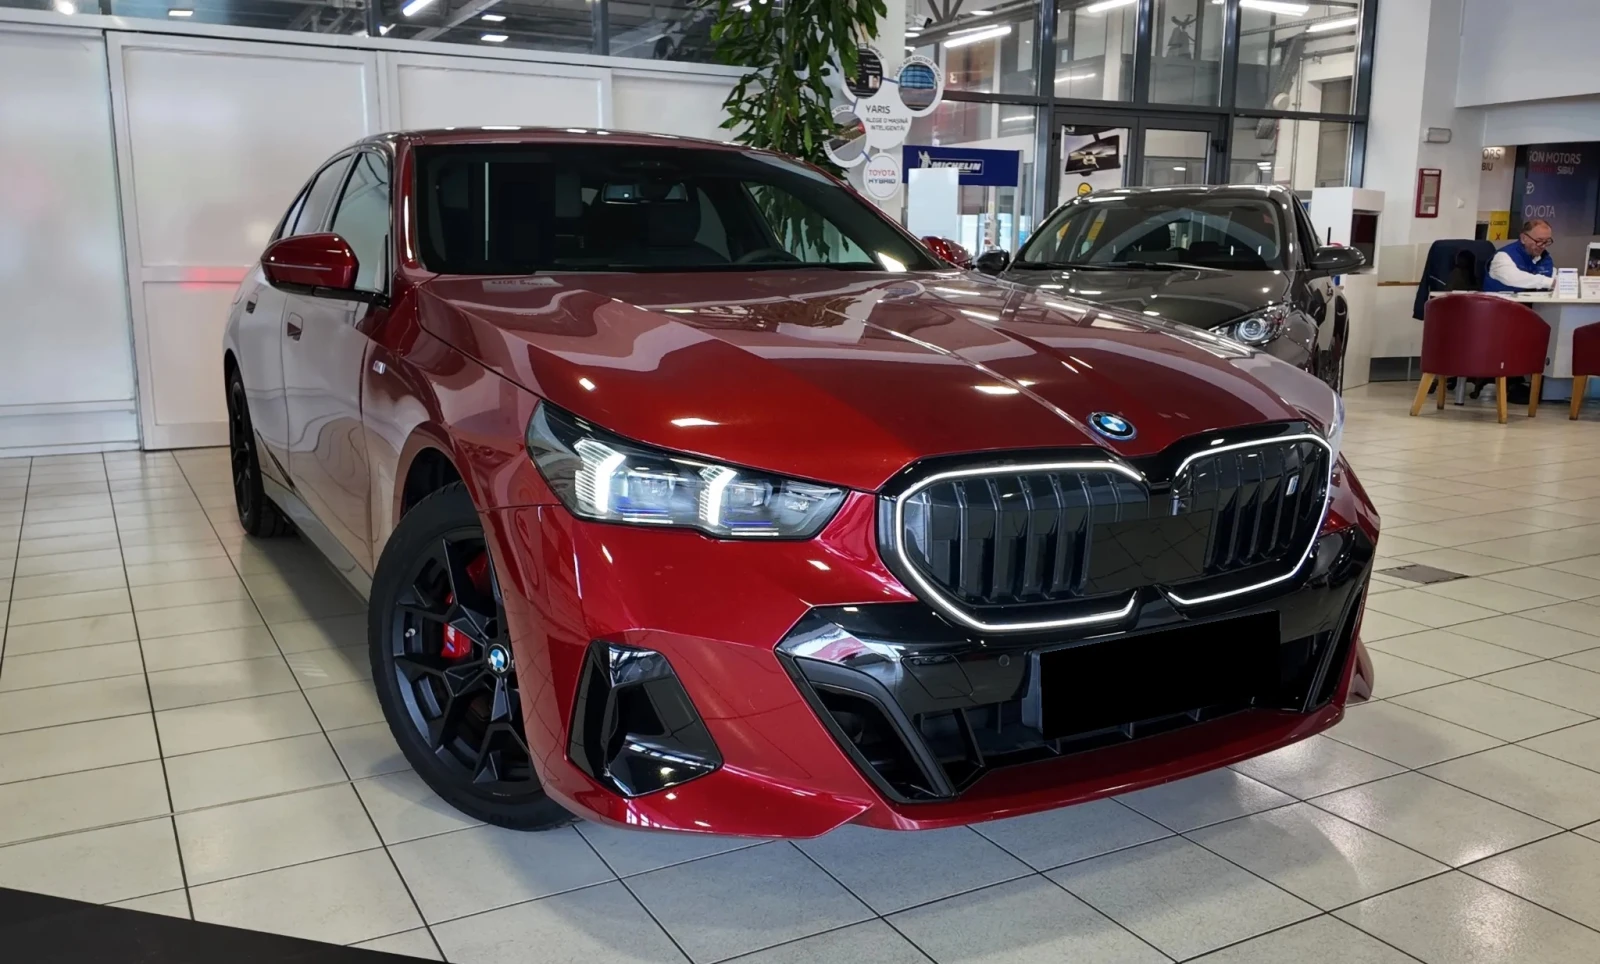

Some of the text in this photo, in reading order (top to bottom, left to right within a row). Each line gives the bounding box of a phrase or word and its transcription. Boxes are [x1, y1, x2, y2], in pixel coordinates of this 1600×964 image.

[866, 105, 891, 114] YARIS
[1545, 151, 1582, 165] MOTORS
[931, 161, 982, 171] MICHELIN
[1556, 165, 1575, 175] SIBIU
[868, 169, 896, 177] TOYOTA
[1524, 204, 1556, 218] OYOTA
